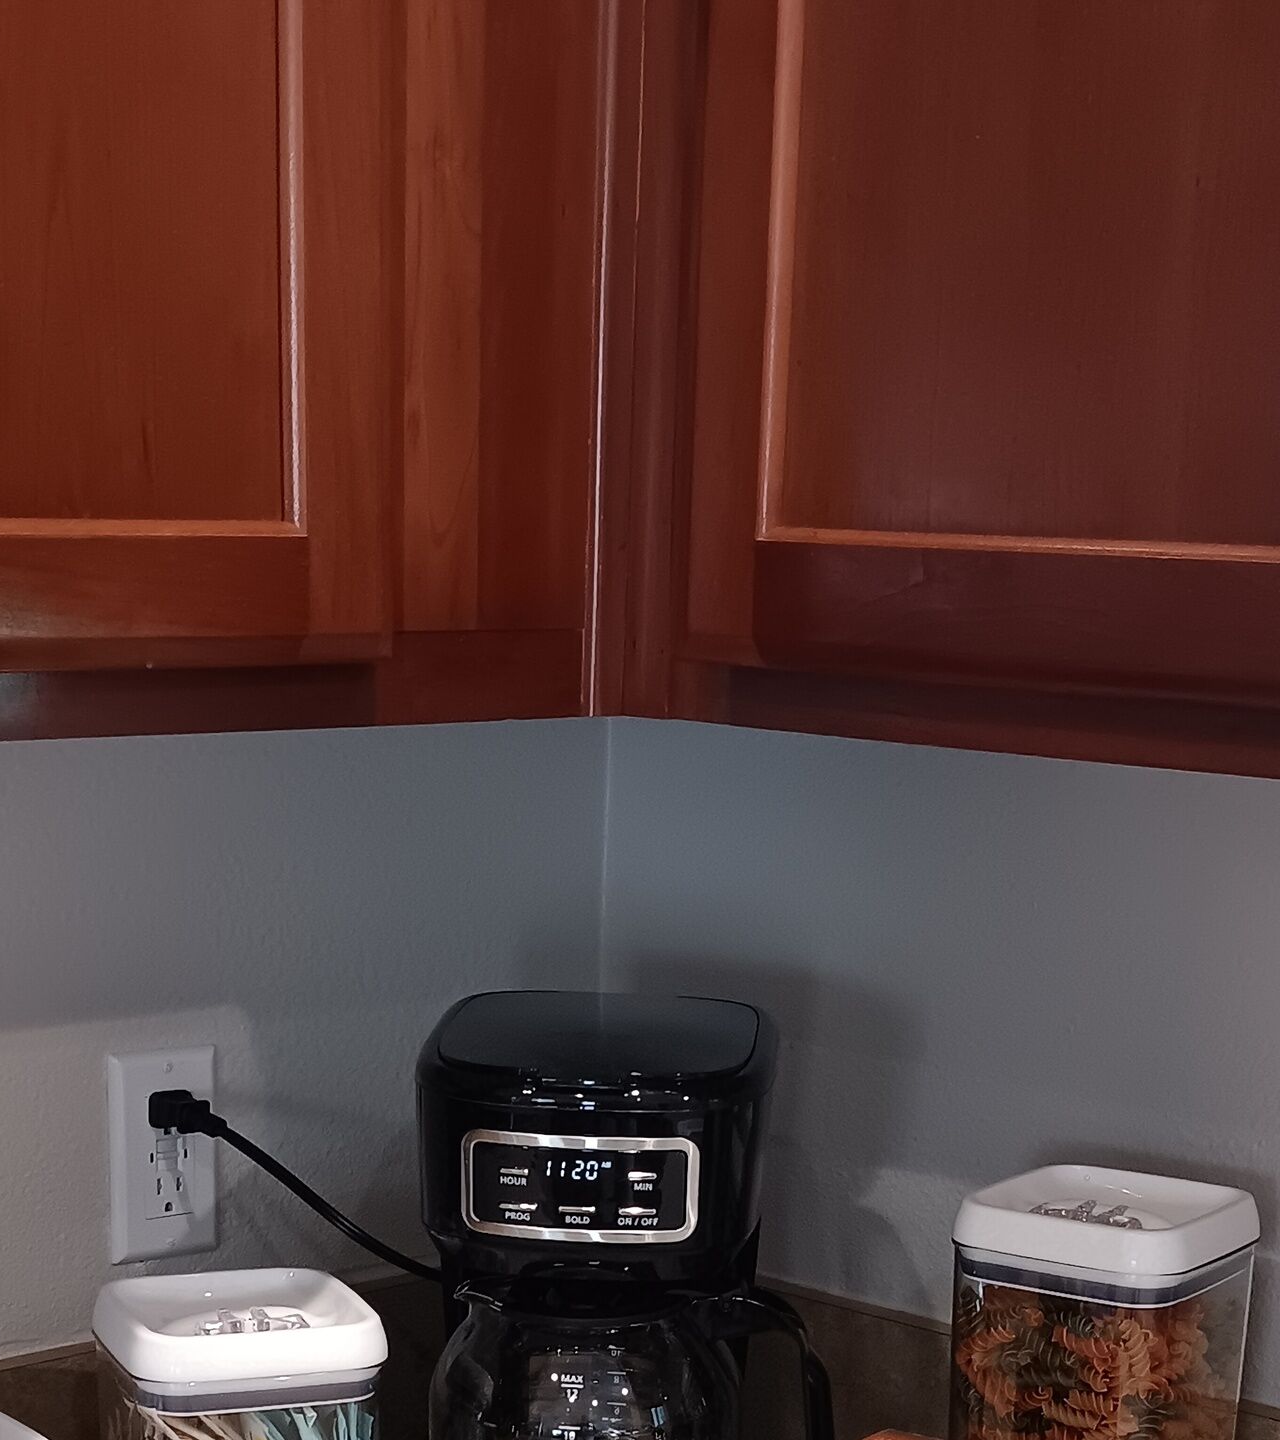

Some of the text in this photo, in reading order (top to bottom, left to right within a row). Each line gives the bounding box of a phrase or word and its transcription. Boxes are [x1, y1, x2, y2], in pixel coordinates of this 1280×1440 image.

[499, 1176, 527, 1186] HOUR
[633, 1183, 653, 1192] MIN
[505, 1211, 531, 1221] PROG
[565, 1215, 590, 1225] BOLD
[617, 1217, 632, 1226] ON
[641, 1217, 659, 1227] OFF
[560, 1374, 583, 1383] MAX
[566, 1389, 579, 1400] 12
